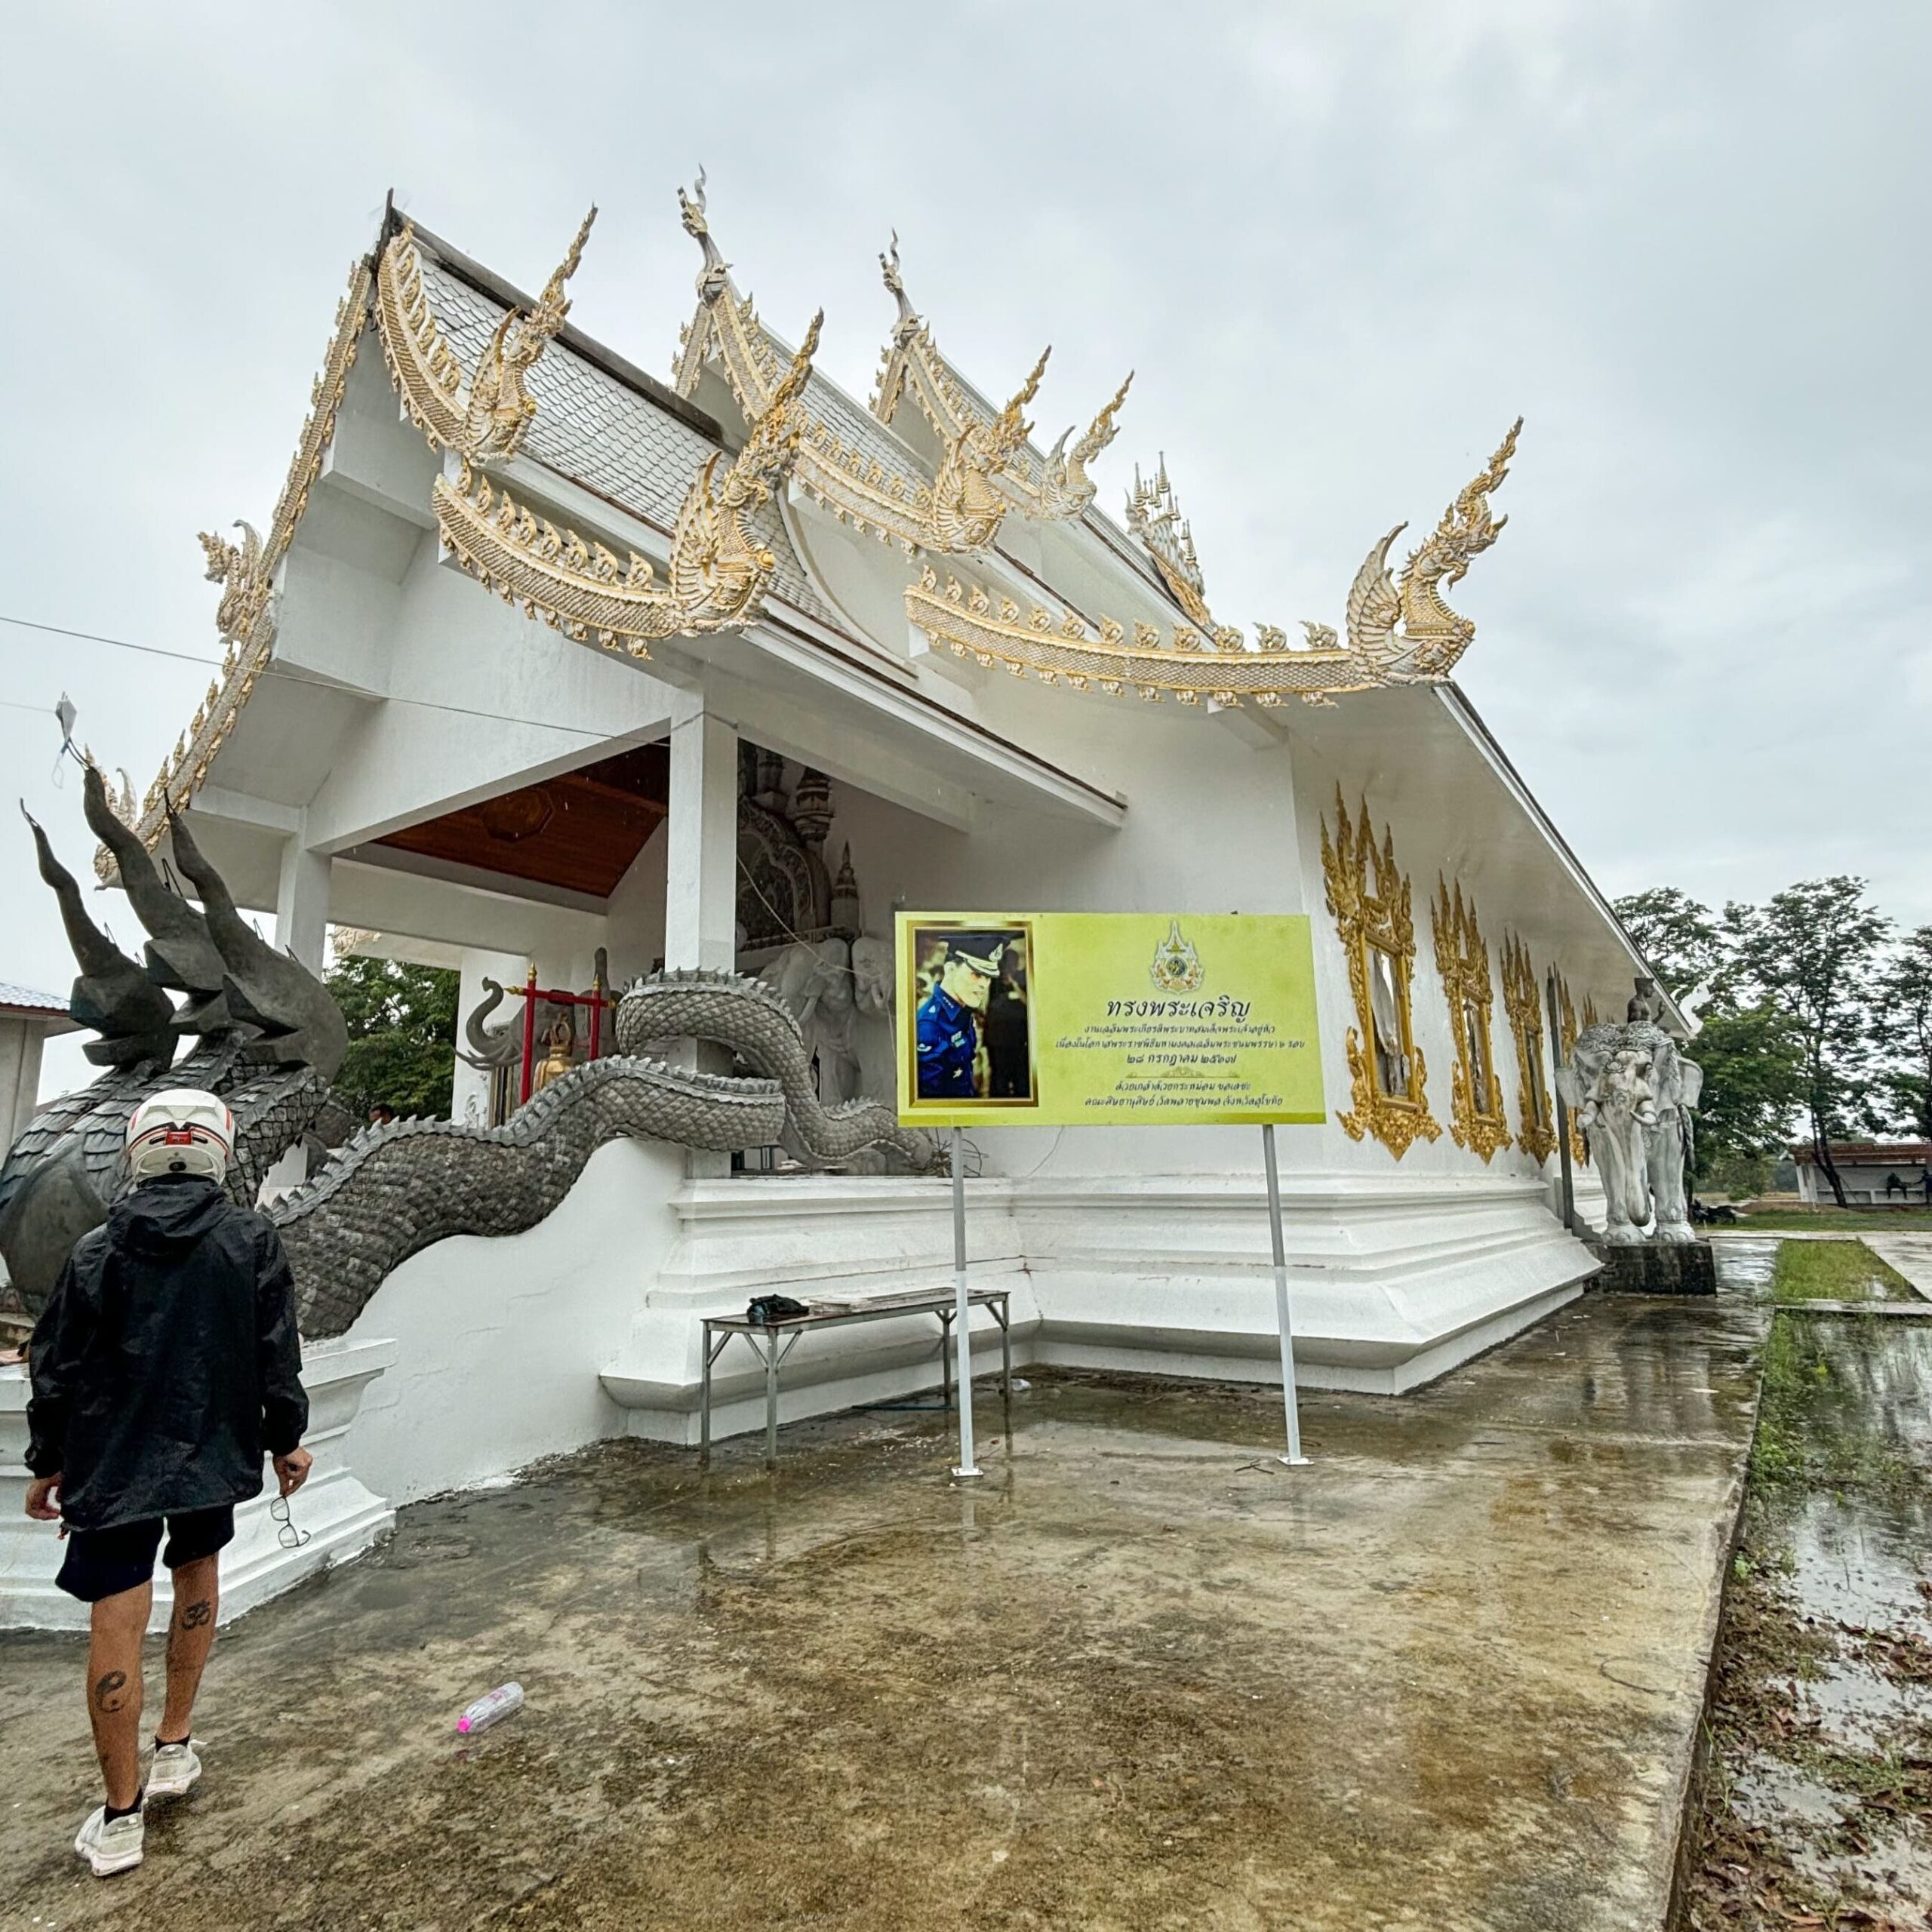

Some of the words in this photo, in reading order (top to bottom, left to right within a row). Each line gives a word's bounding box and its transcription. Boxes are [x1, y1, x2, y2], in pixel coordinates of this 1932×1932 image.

[1107, 995, 1251, 1023] ทรงพระเจริญ
[1127, 1054, 1145, 1063] ๒๘
[1148, 1054, 1198, 1066] กรกฎาคม
[1201, 1053, 1237, 1064] ๒๕๖๗
